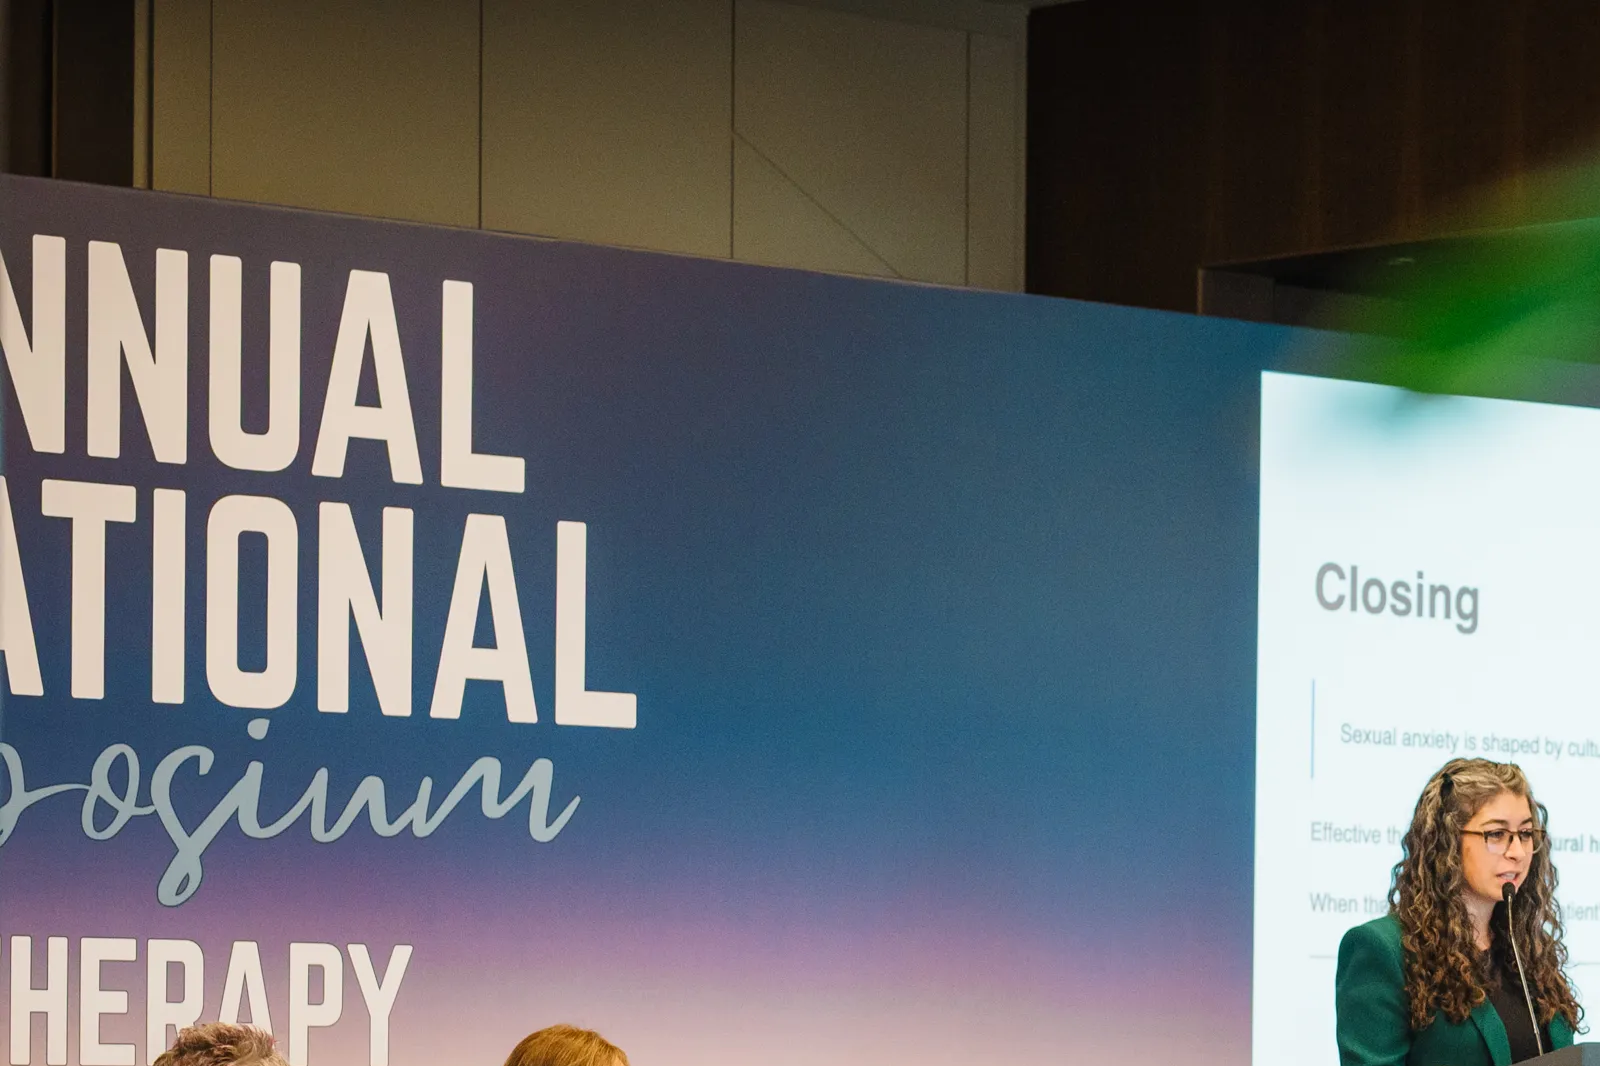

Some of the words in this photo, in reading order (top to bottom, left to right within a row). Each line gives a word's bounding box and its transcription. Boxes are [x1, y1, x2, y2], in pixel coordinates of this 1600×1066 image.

[1315, 561, 1479, 634] Closing
[1340, 722, 1397, 746] Sexual
[1402, 727, 1459, 751] anxiety
[1464, 732, 1476, 750] is
[1482, 732, 1540, 755] shaped
[1545, 736, 1563, 760] by
[1310, 821, 1381, 844] Effective
[1309, 891, 1358, 913] When
